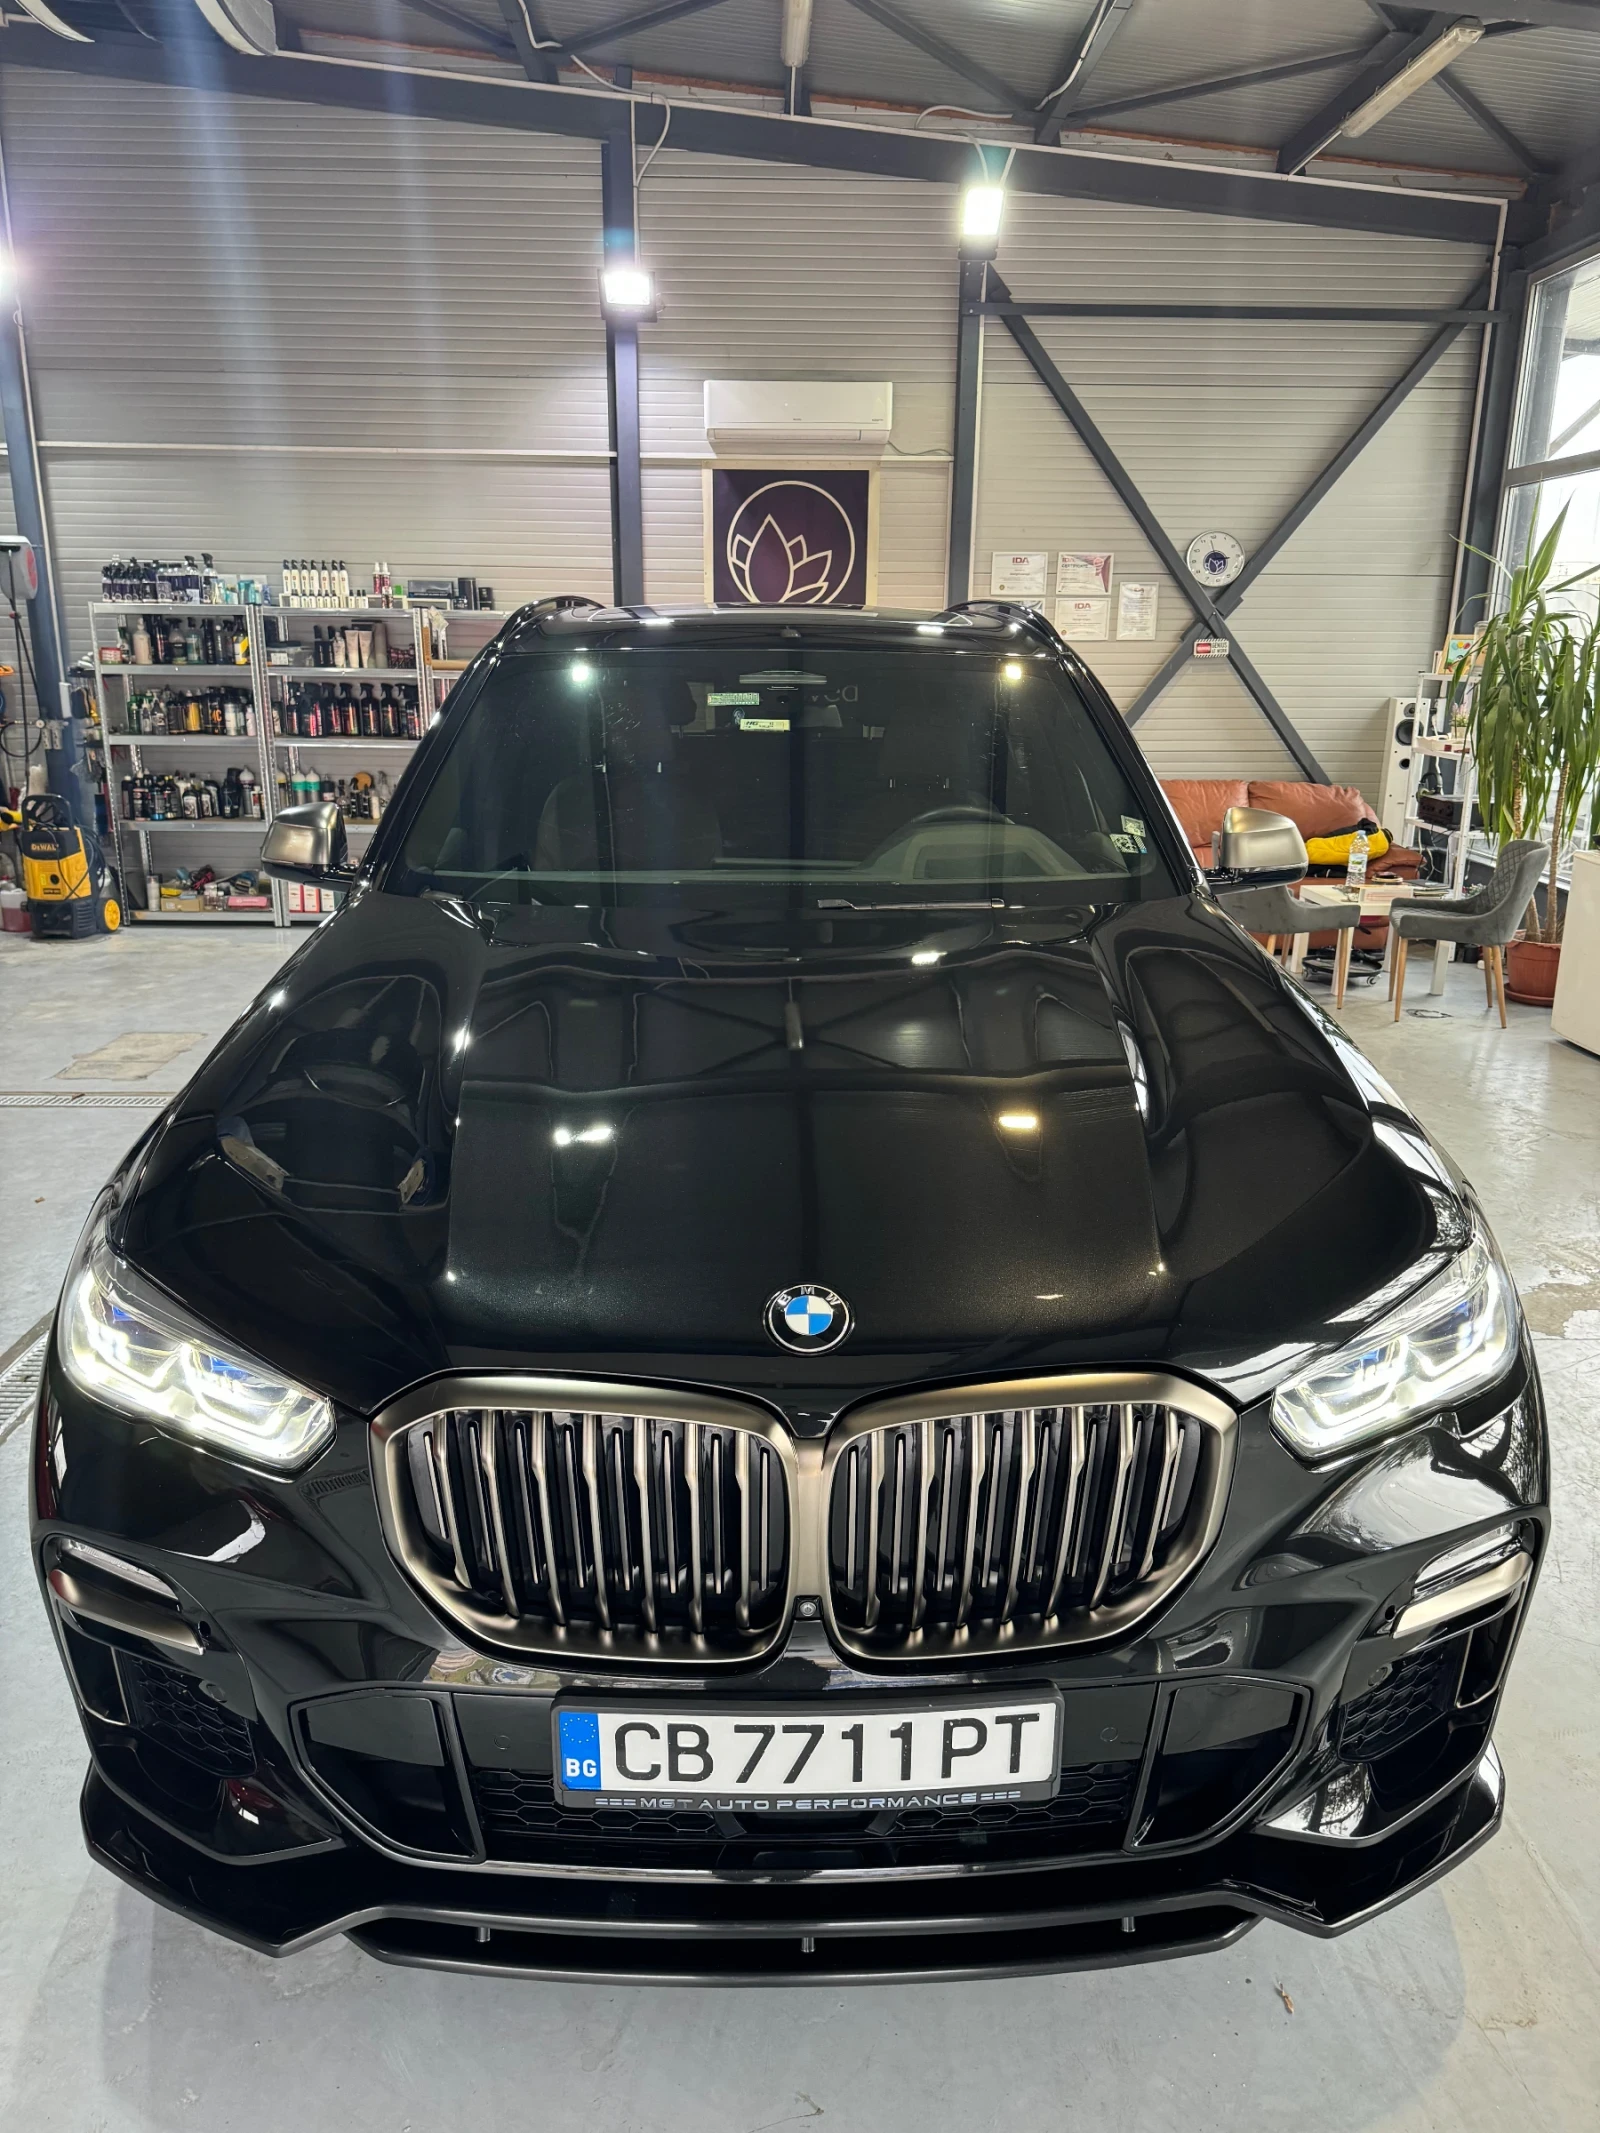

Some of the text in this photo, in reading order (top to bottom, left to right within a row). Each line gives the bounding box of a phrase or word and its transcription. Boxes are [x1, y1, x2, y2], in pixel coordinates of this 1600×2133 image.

[1012, 556, 1029, 564] IDA
[1074, 602, 1091, 610] IDA
[776, 1286, 841, 1306] BMW
[566, 1757, 597, 1777] BG
[639, 1792, 978, 1811] MGT AUTO PERFORMANCE
